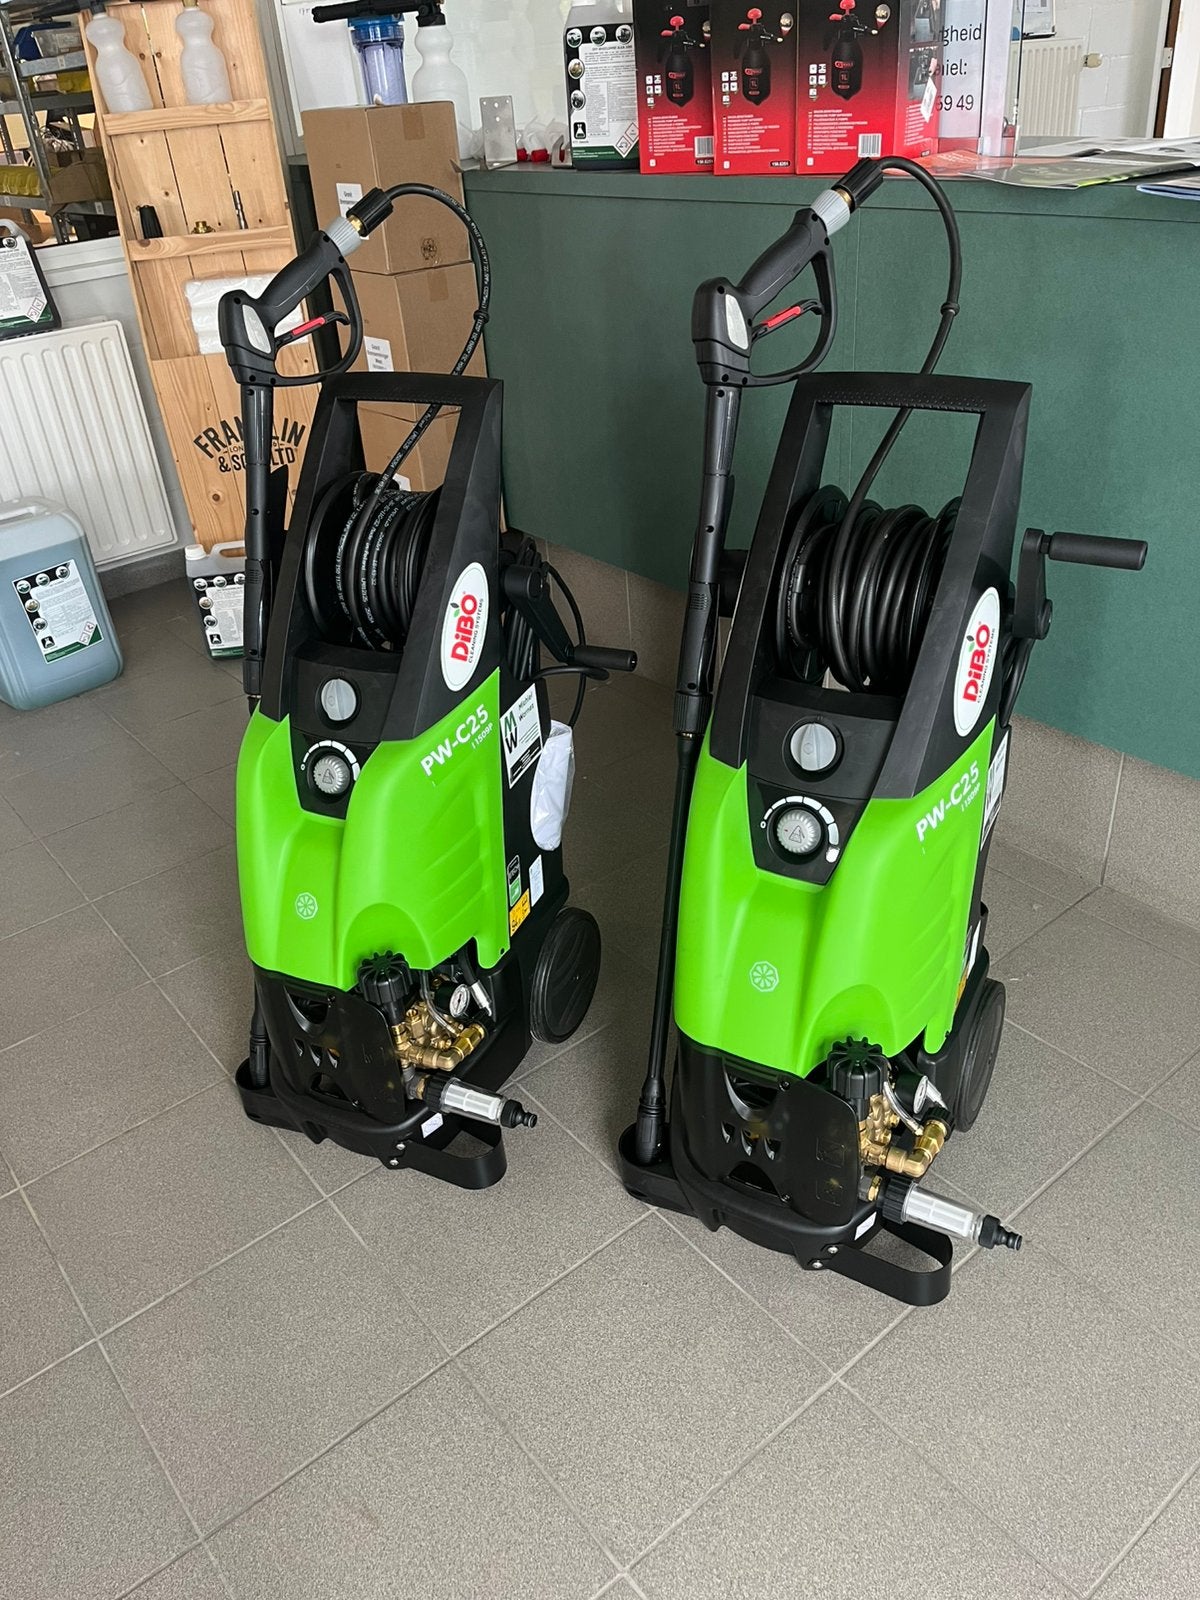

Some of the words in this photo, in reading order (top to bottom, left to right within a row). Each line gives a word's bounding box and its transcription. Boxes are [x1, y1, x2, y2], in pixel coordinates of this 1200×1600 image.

[956, 94, 974, 111] 49
[193, 416, 306, 459] FRAIN
[218, 455, 231, 472] &
[271, 447, 296, 466] LTD
[451, 594, 478, 662] DiBO
[468, 630, 478, 664] CLEANING
[475, 598, 484, 629] SYSTEMS
[962, 624, 990, 702] DiBO
[420, 703, 489, 777] PW-C25
[915, 760, 979, 842] PW-C25
